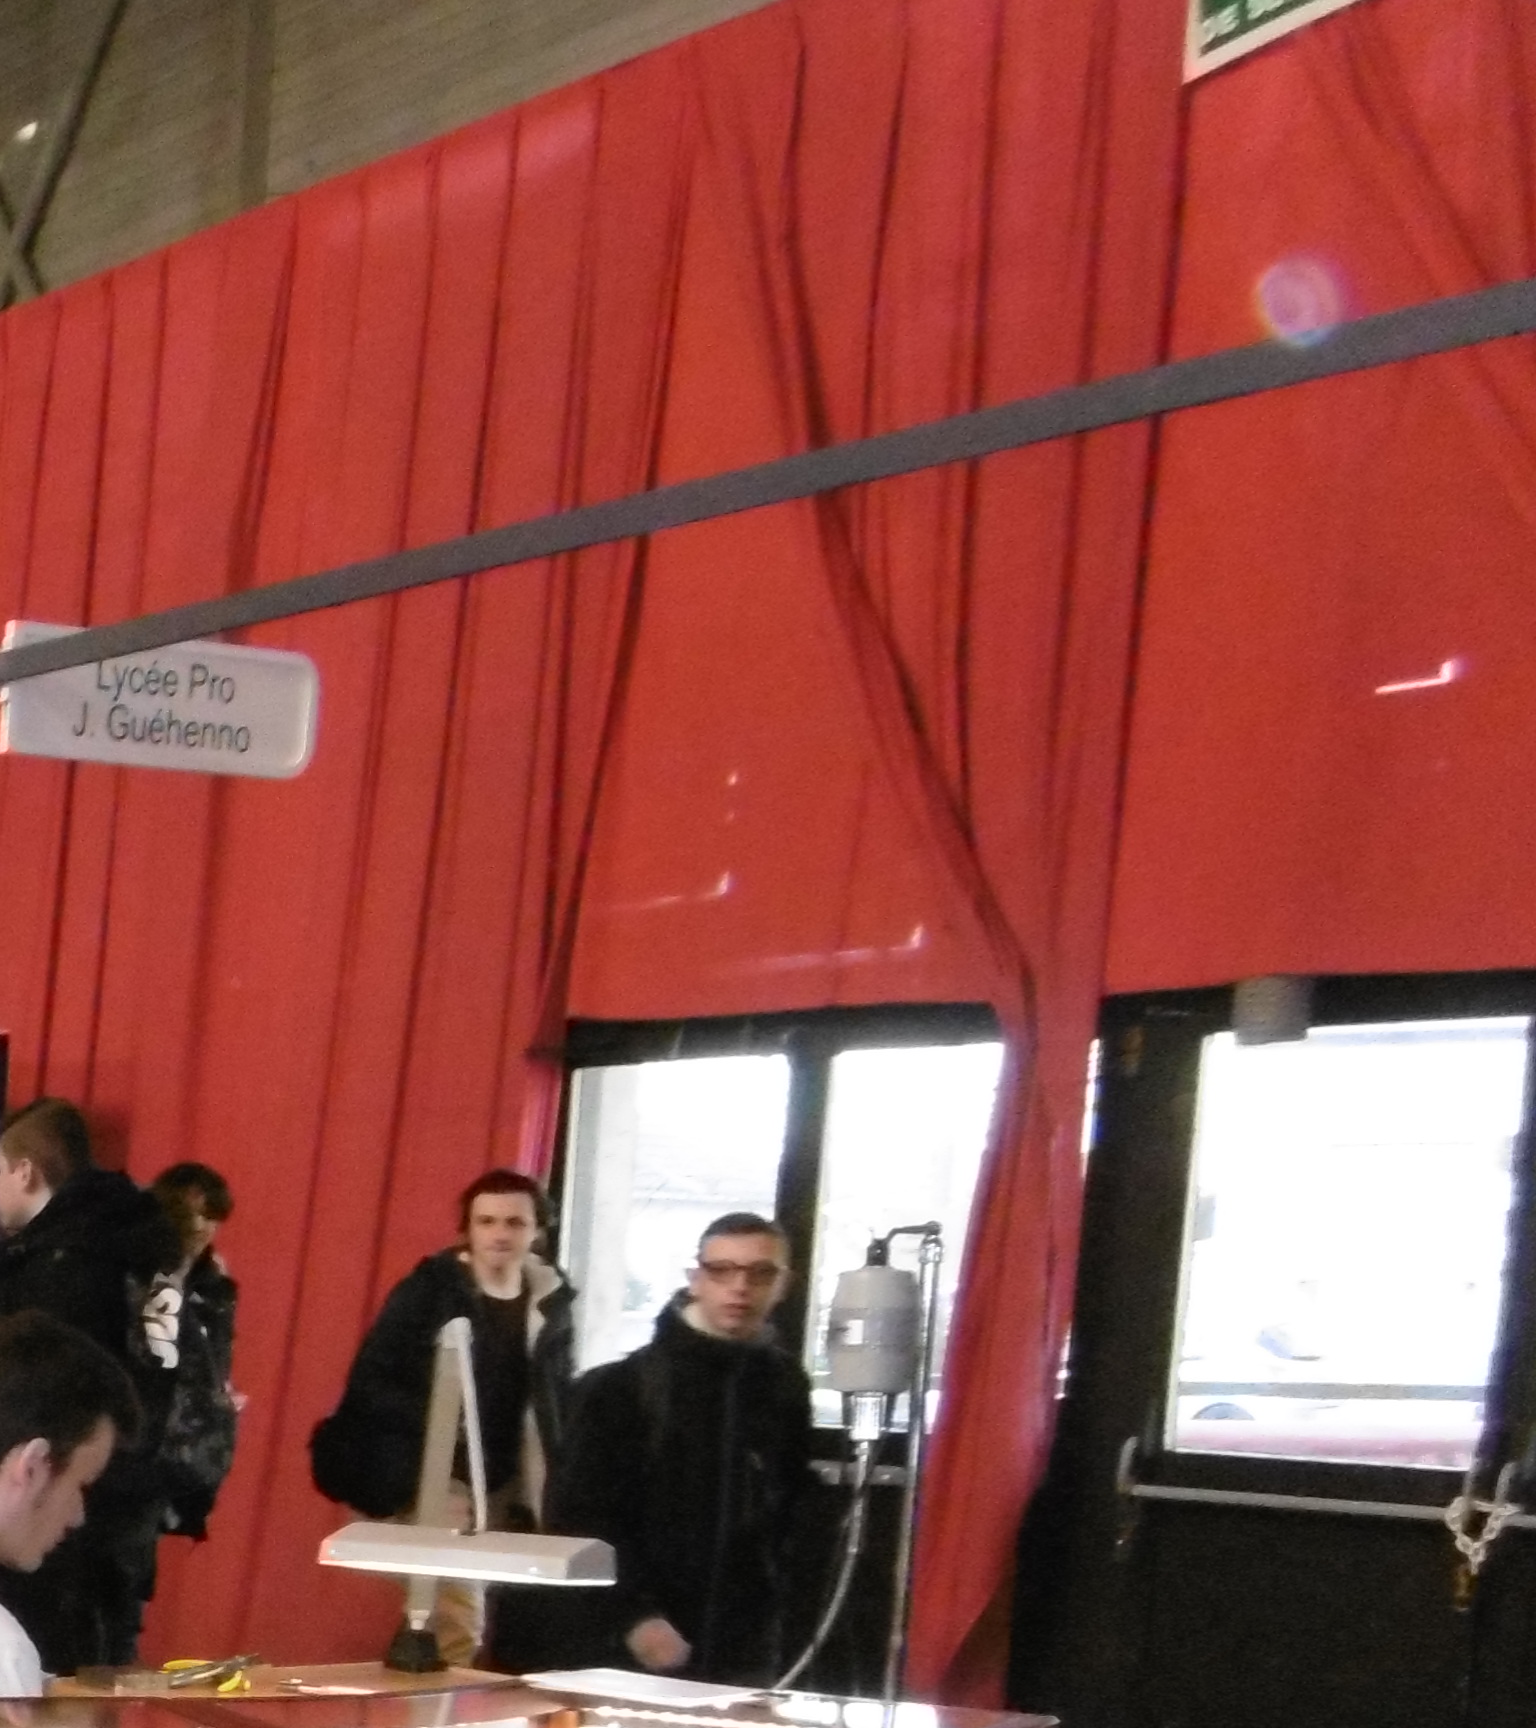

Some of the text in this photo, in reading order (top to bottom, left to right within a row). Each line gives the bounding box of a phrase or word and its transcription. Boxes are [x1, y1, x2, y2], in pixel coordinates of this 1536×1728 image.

[97, 660, 236, 705] Lycée Pro
[73, 703, 251, 754] J. Guéhenno
